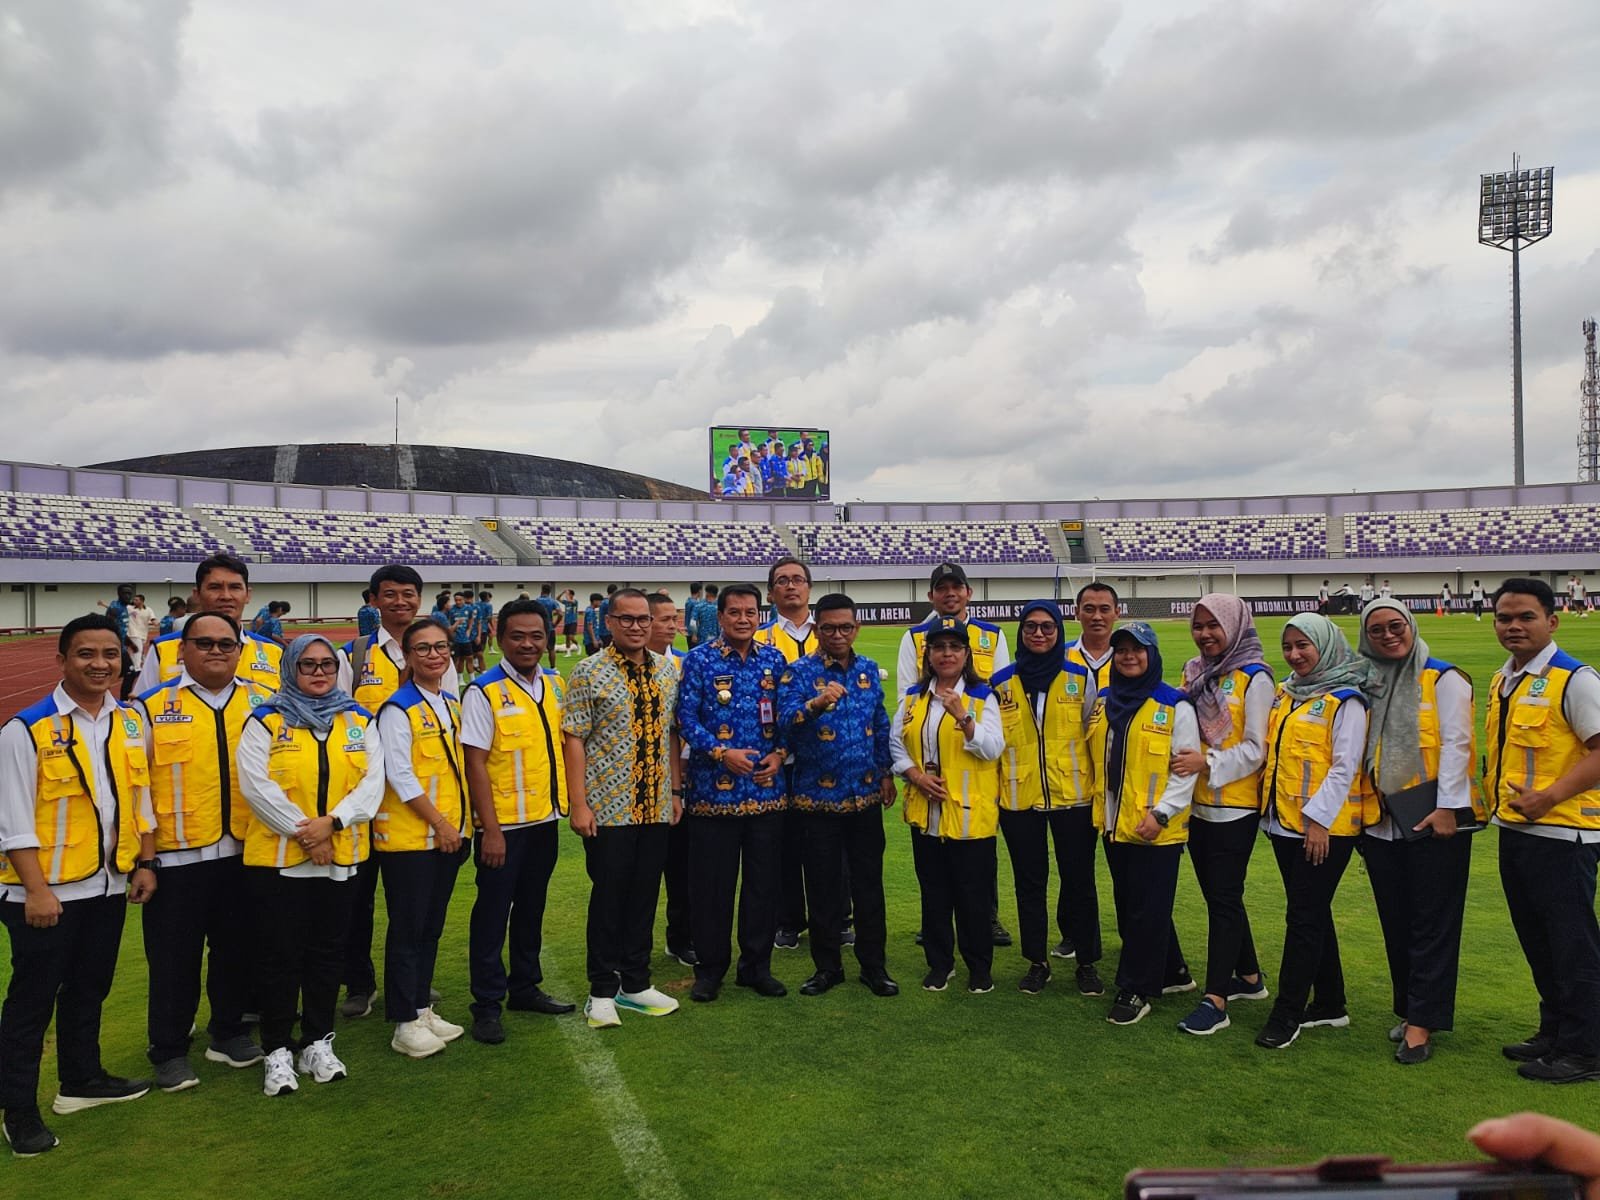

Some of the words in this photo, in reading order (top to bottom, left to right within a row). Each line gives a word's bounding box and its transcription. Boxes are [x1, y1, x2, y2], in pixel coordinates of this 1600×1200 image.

[965, 605, 1011, 618] ERESMIAN
[1255, 601, 1293, 612] INDOMILK
[1295, 600, 1319, 611] ARENA
[856, 608, 877, 621] MILK
[880, 608, 911, 620] ARENA
